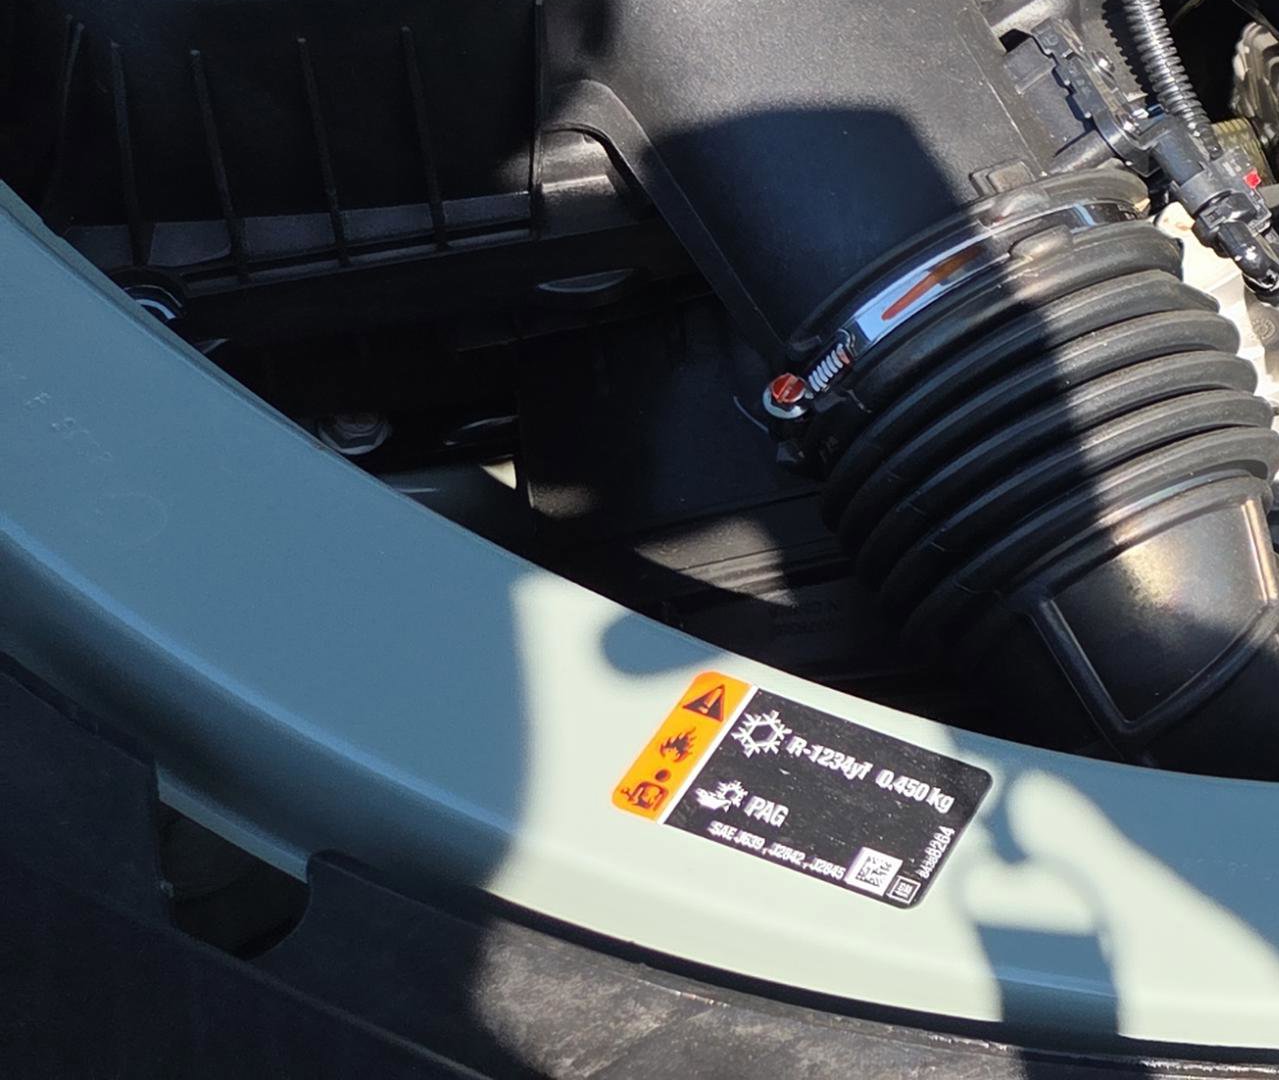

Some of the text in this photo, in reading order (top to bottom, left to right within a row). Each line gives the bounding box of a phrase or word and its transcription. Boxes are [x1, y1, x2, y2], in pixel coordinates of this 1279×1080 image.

[786, 736, 955, 814] R-1234yf 0.450 kg
[743, 795, 789, 828] PAG
[707, 820, 737, 841] SAE
[810, 857, 847, 880] J2845
